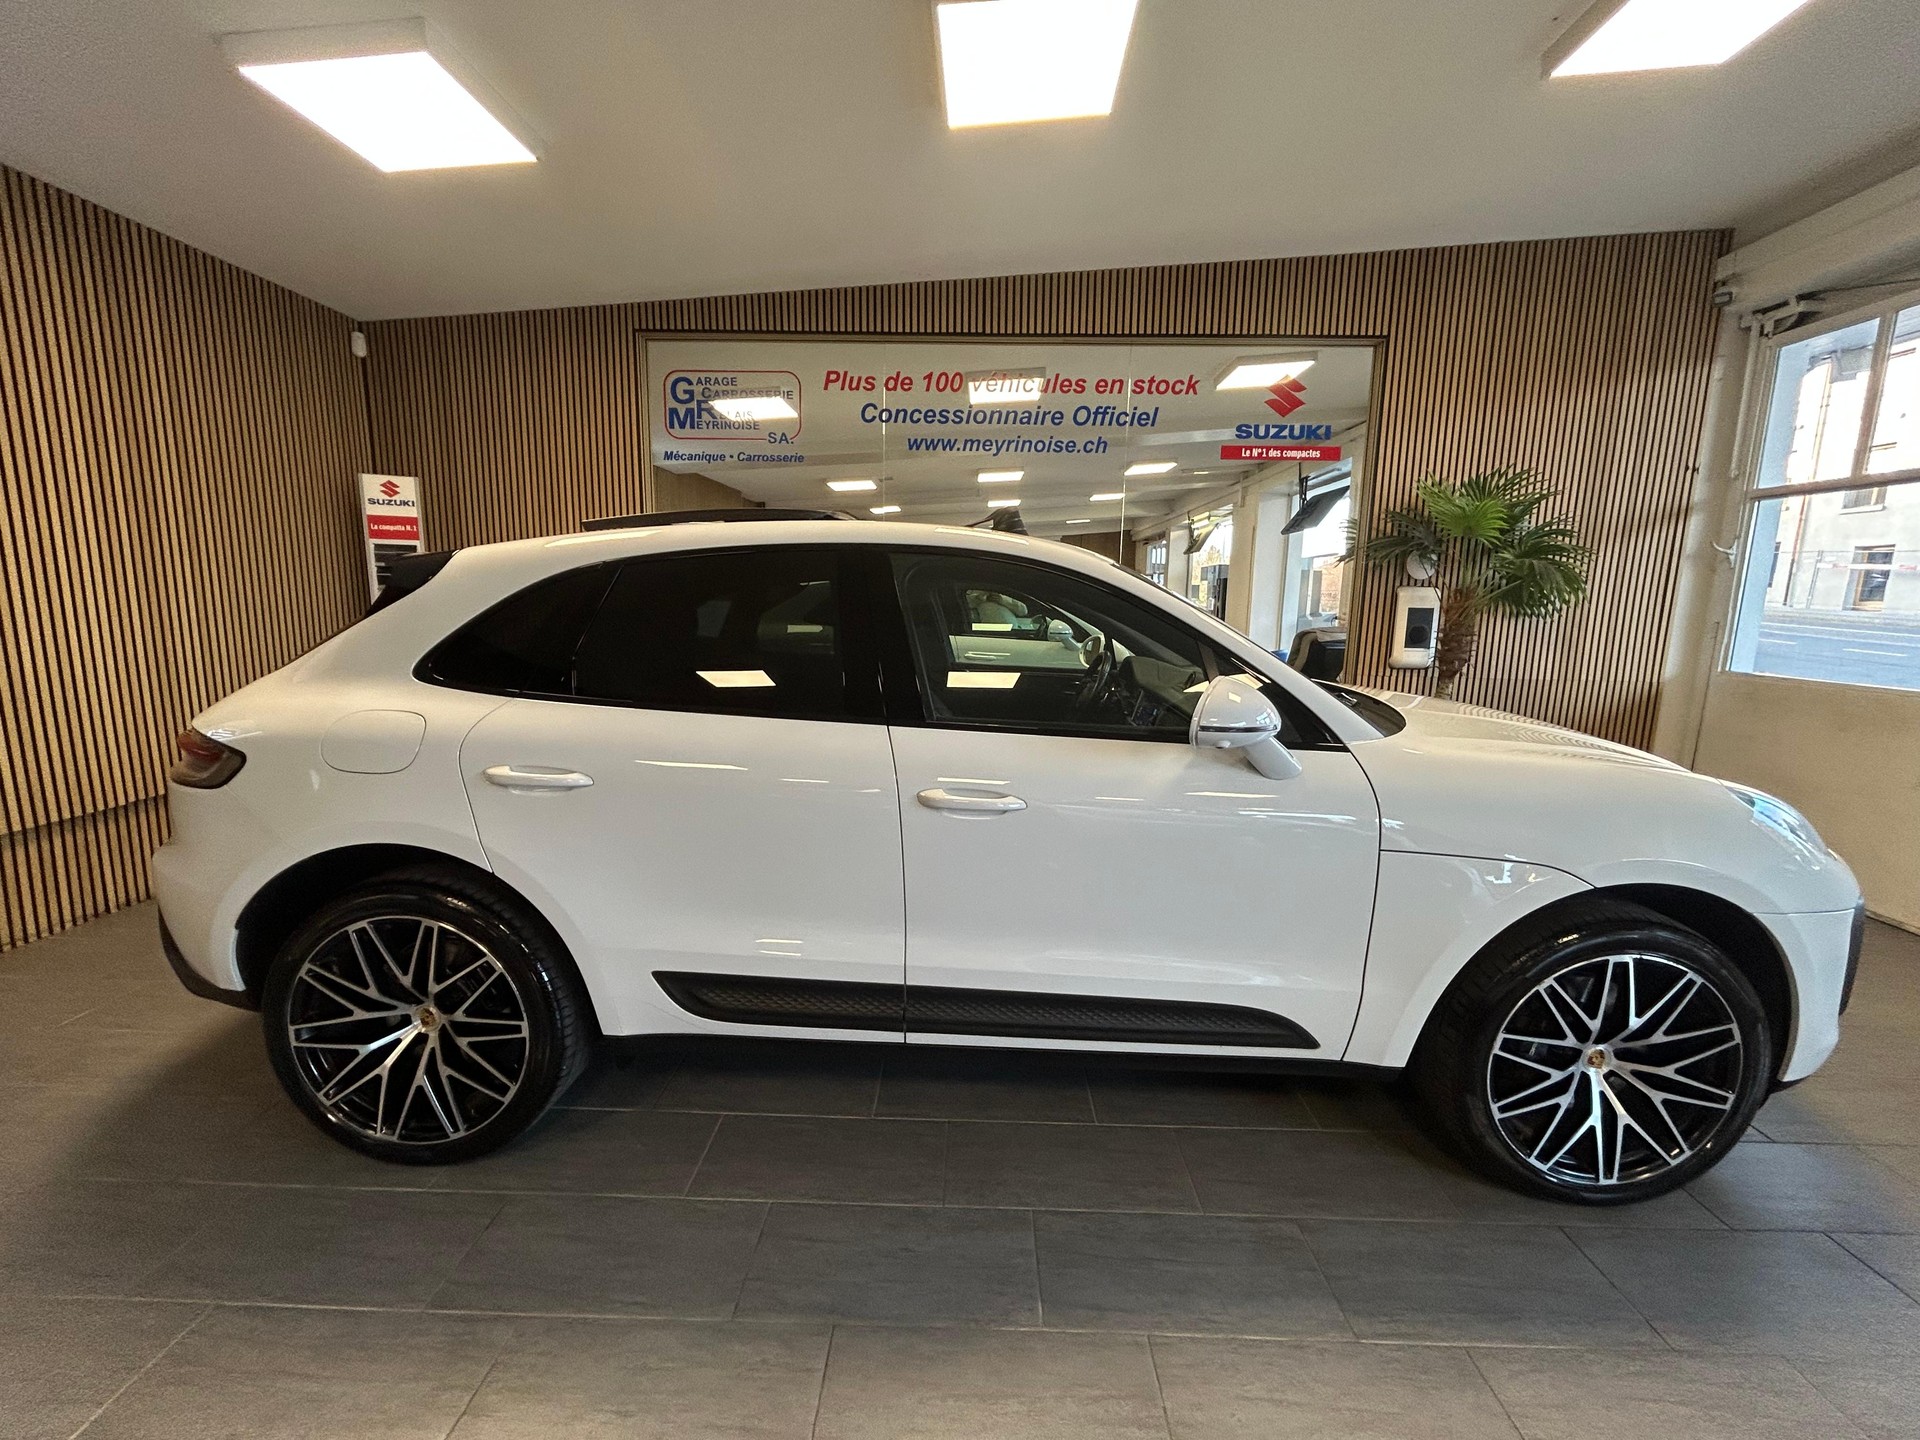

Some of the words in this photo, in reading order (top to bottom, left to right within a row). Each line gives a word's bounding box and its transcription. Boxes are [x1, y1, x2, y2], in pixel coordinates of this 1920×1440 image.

[670, 376, 738, 405] GARAGE
[823, 370, 876, 392] Plus
[884, 371, 914, 392] de
[922, 371, 964, 393] 100
[973, 371, 1086, 394] véhicules
[1094, 377, 1124, 394] en
[1131, 374, 1200, 395] stock
[668, 407, 760, 430] MEYRINOISE
[861, 402, 1064, 426] Concessionnaire
[1072, 405, 1159, 427] Officiel
[767, 431, 795, 445] SA.
[1235, 423, 1332, 440] SUZUKI
[907, 436, 1108, 457] www.meyrinoise.ch
[1241, 447, 1251, 458] Le
[1268, 447, 1281, 458] des
[1282, 448, 1321, 459] compactes
[663, 450, 727, 464] Mécanique
[737, 451, 805, 464] Carrosserie
[367, 498, 415, 507] SUZUKI
